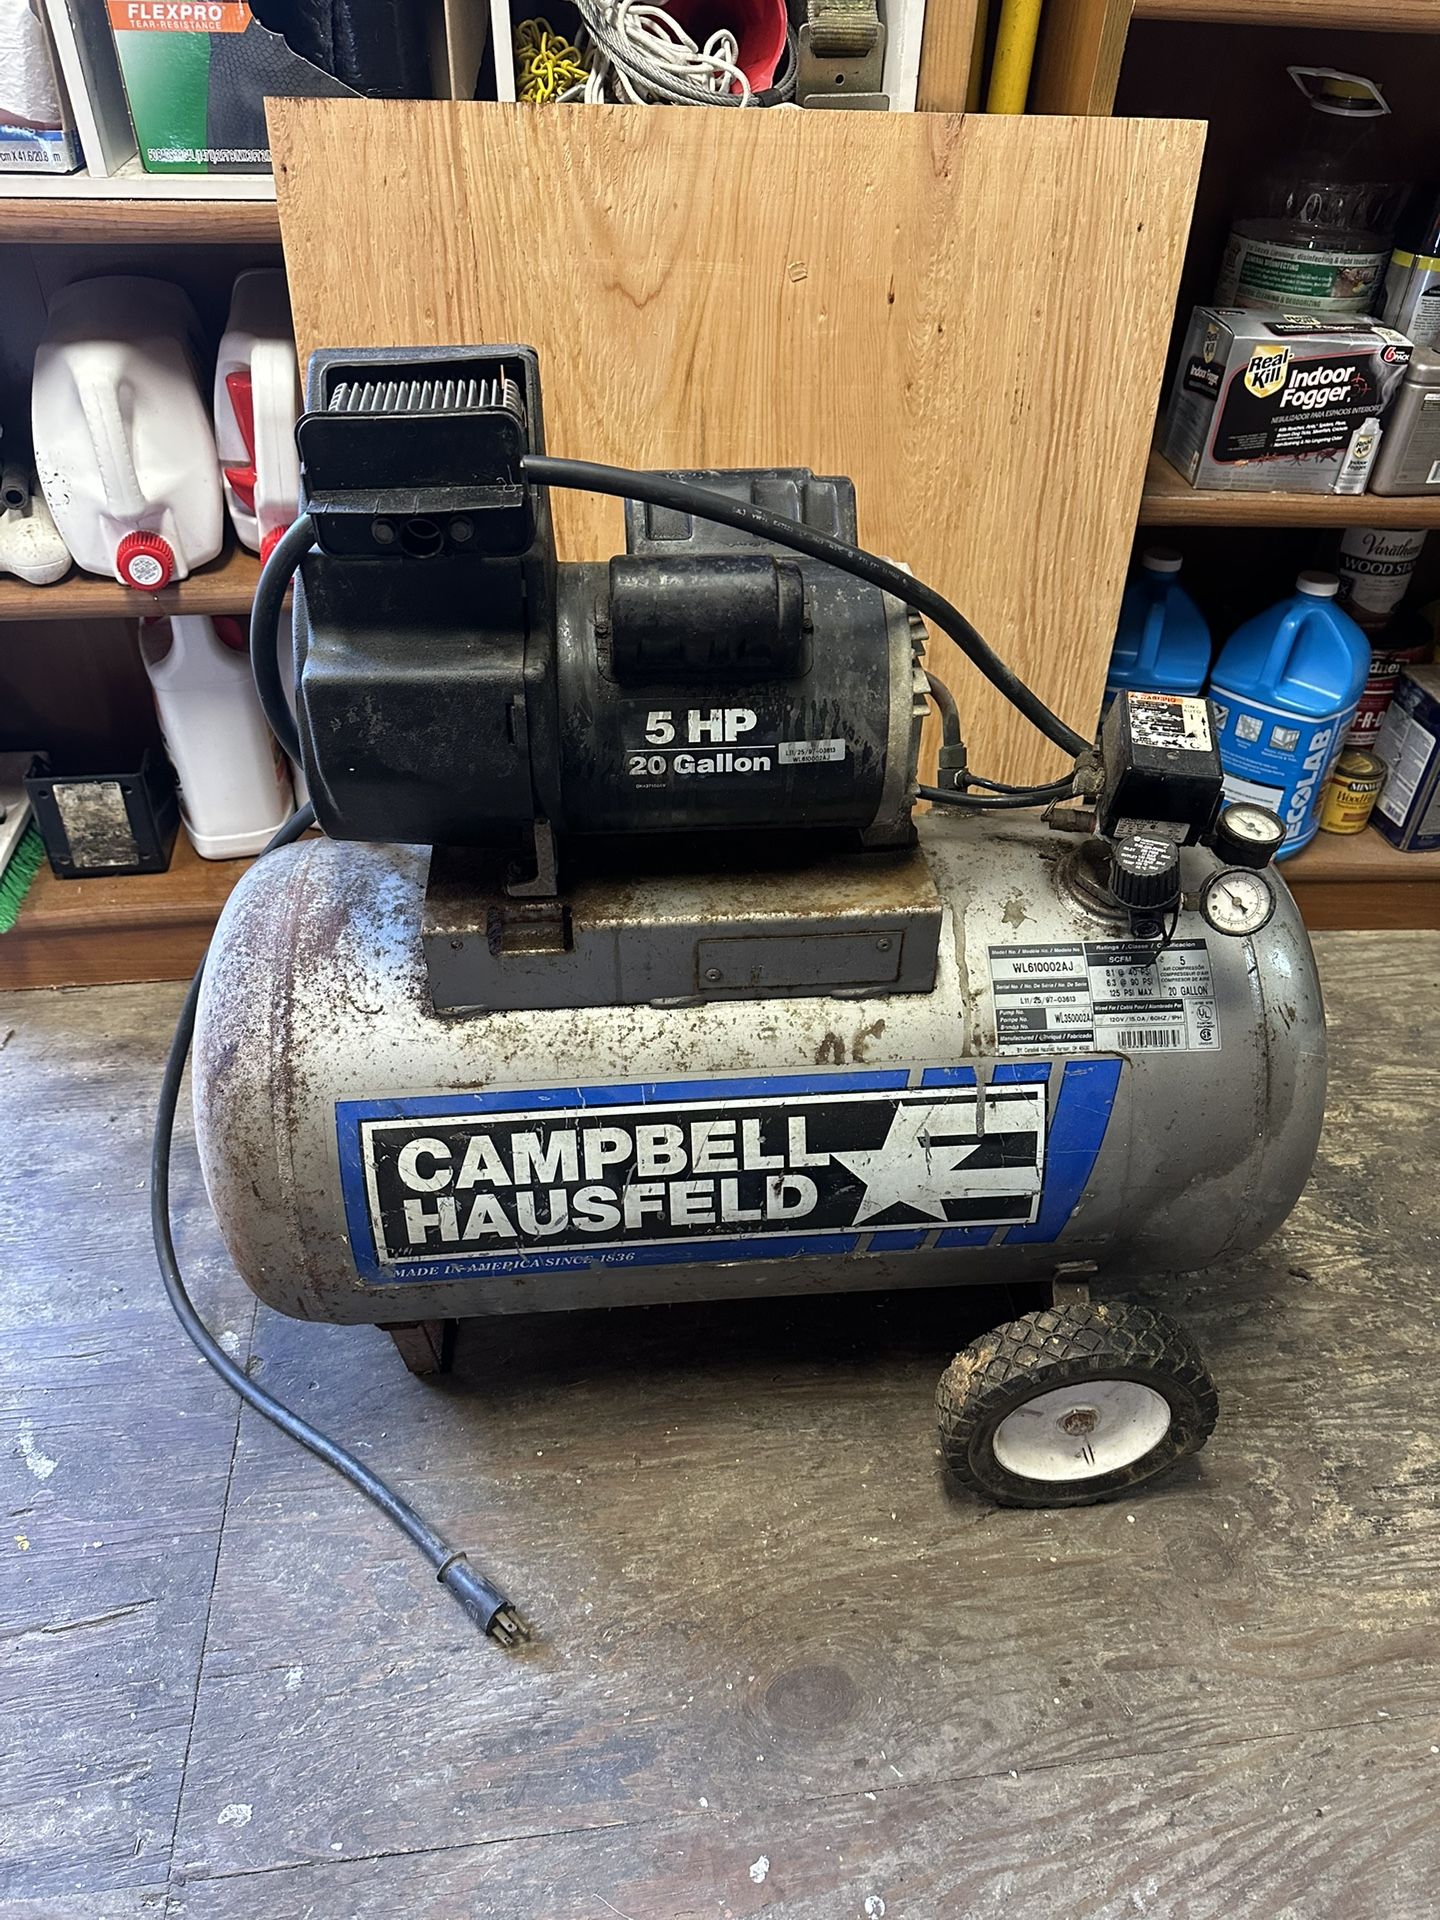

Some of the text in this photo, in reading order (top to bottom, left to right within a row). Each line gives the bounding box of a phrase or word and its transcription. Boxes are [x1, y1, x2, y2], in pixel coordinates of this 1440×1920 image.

[127, 4, 222, 20] FLEXPRO
[130, 20, 222, 29] TEAR-RESISTANCE
[1384, 346, 1396, 362] 6
[1251, 366, 1281, 389] Kill
[1288, 366, 1356, 388] Indoor
[1325, 408, 1351, 418] ESPACIOS
[1345, 556, 1394, 575] WOOD
[645, 708, 757, 744] 5 HP
[628, 752, 771, 776] 20 Gallon
[1286, 728, 1332, 840] ECOLAB
[1012, 961, 1074, 973] WL610002AJ
[1179, 956, 1186, 965] 5
[1109, 988, 1154, 997] 125 PSI MAX
[1168, 985, 1208, 997] 20 GALLON
[397, 1116, 830, 1193] CAMPBELL
[403, 1173, 818, 1244] HAUSFELD
[393, 1266, 439, 1279] MADE
[598, 1252, 636, 1264] 1836
